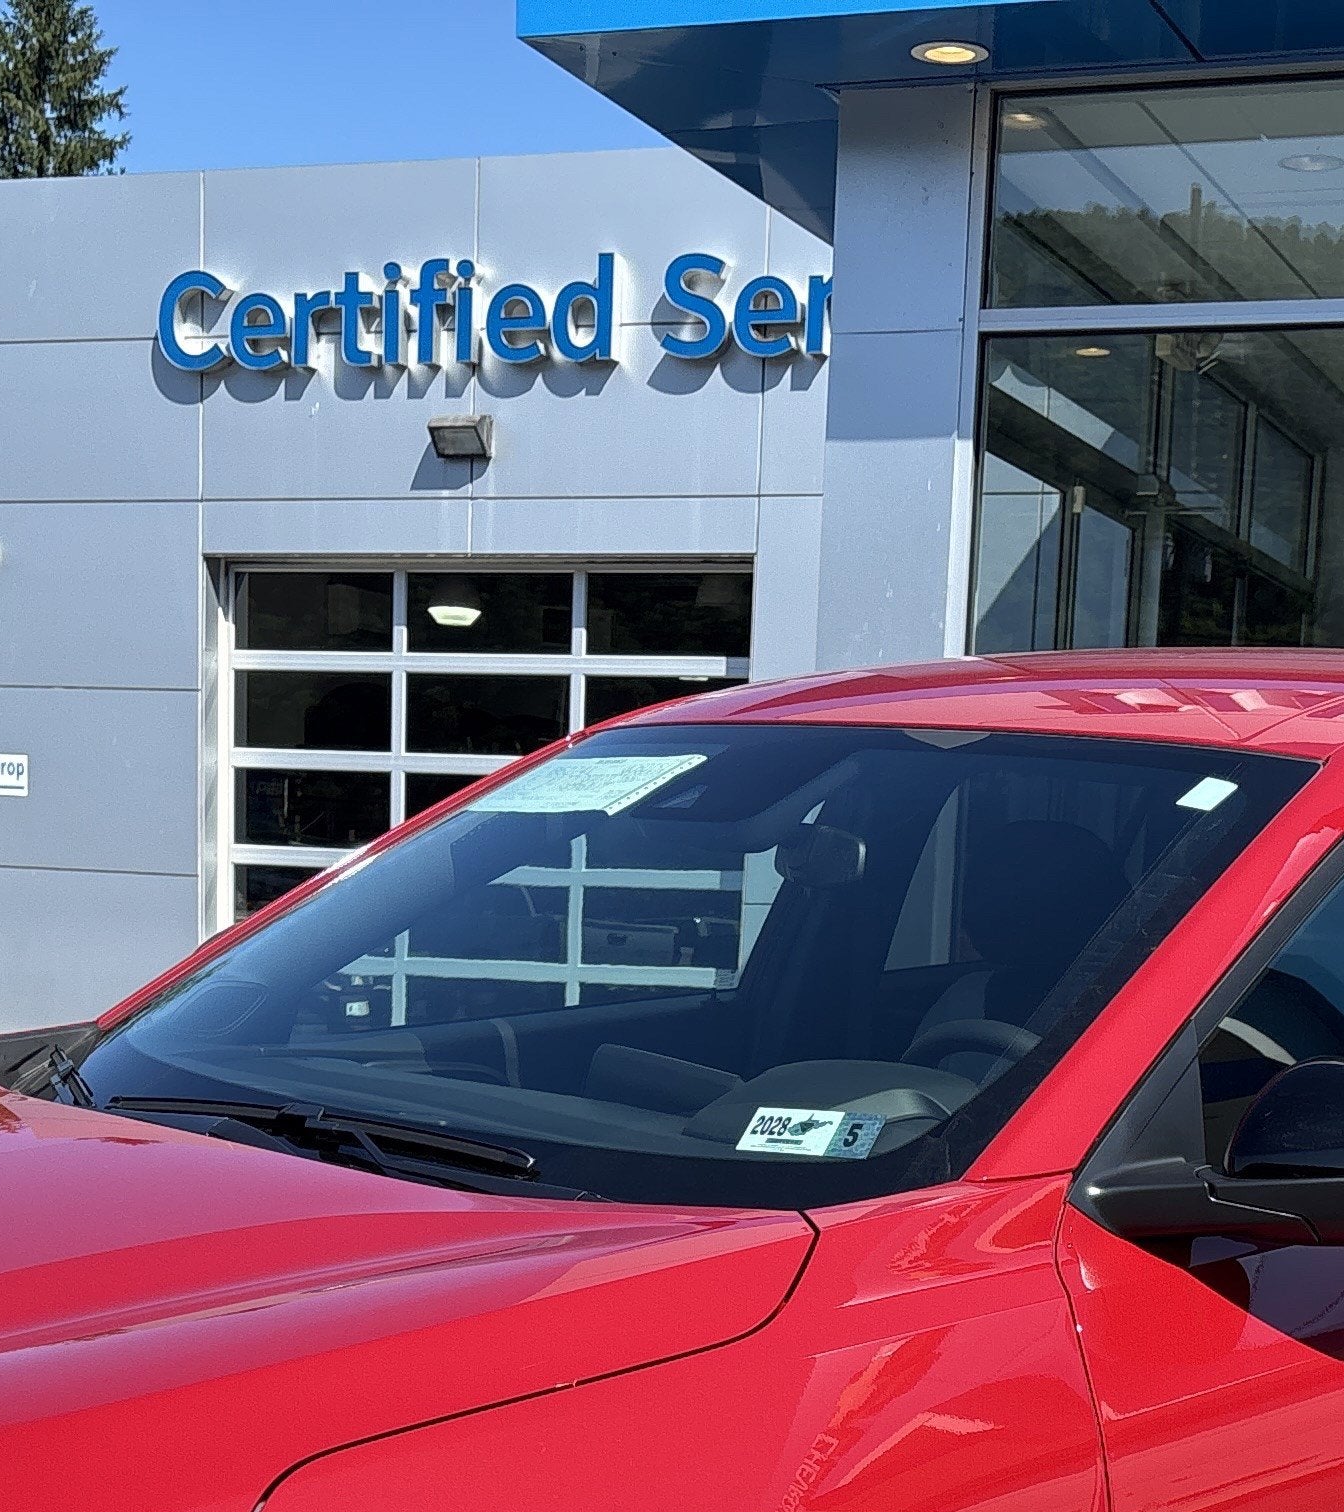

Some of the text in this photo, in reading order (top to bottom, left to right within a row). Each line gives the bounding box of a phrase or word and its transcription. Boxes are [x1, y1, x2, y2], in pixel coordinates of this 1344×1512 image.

[156, 252, 616, 371] Certified
[749, 1115, 864, 1148] 2028 5
